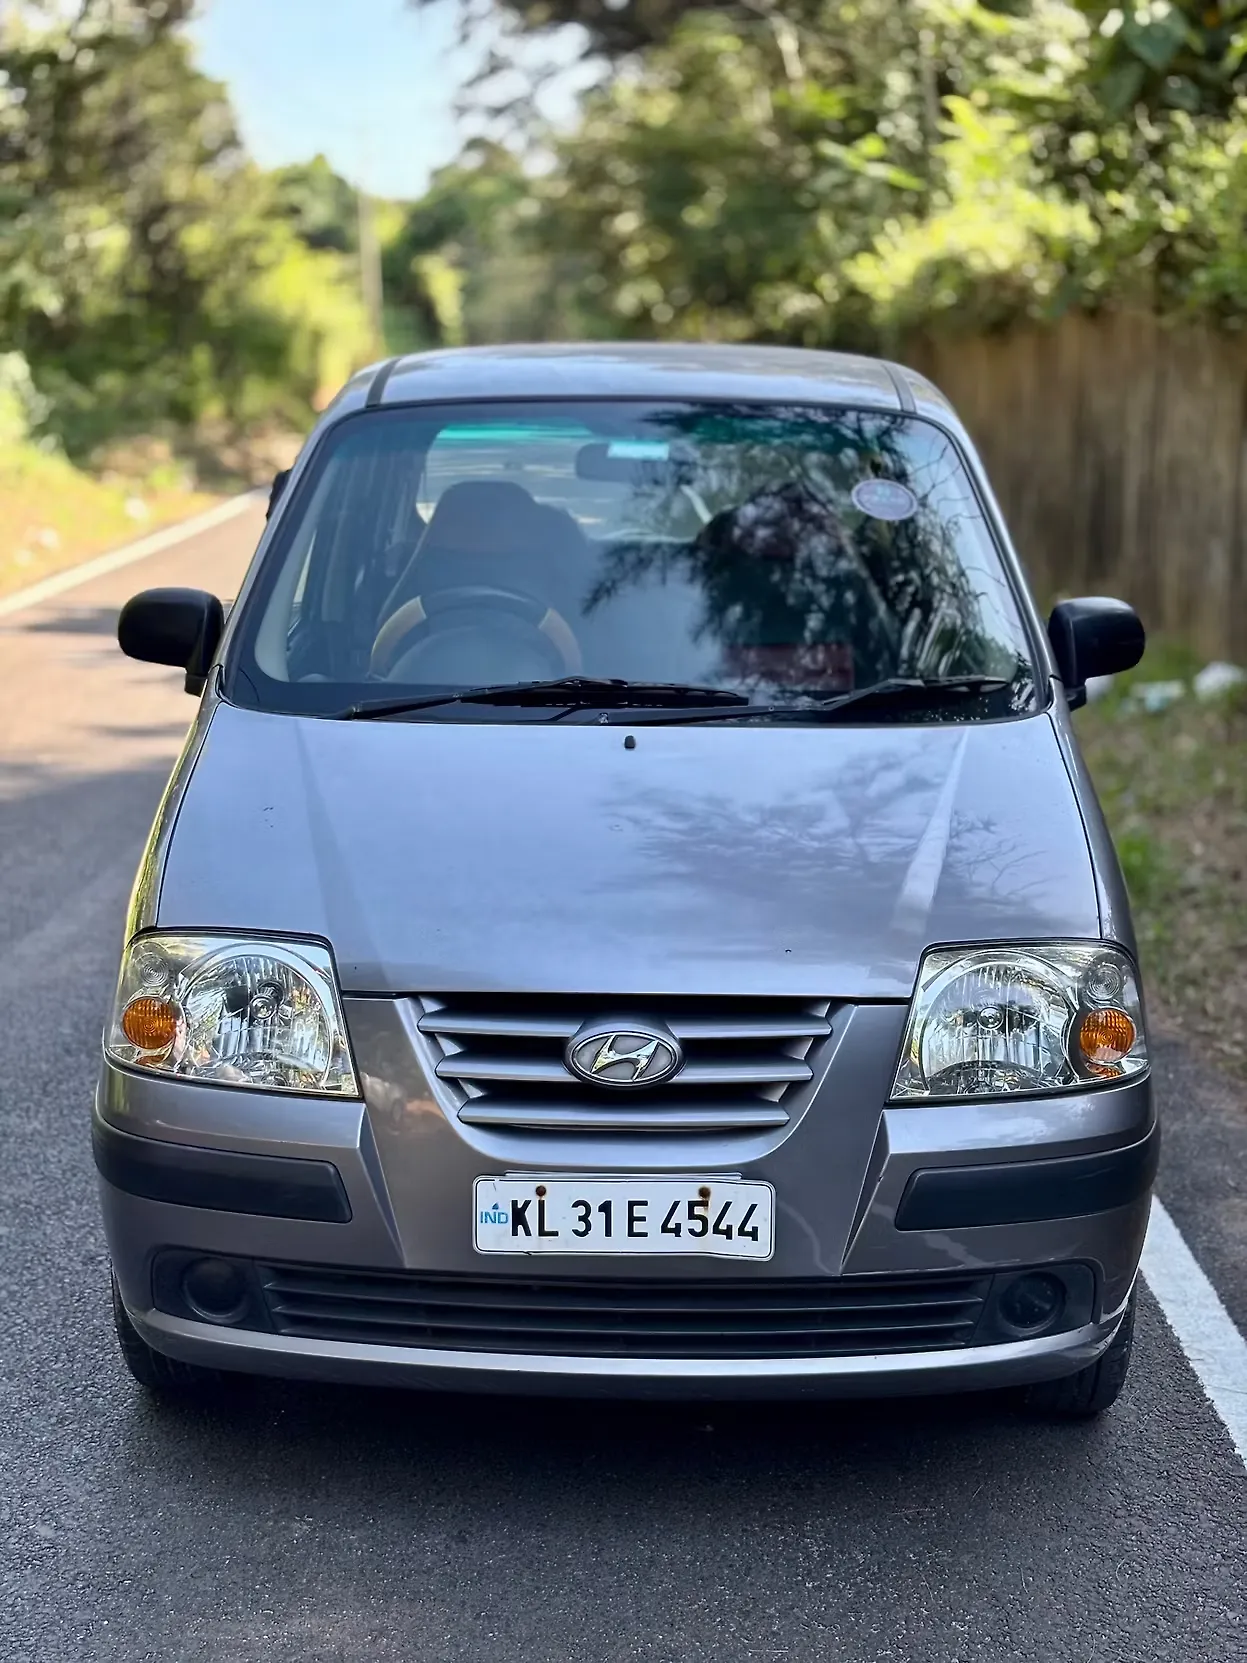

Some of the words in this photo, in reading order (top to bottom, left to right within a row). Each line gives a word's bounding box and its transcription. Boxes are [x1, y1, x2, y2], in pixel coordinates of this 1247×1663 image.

[480, 1210, 509, 1225] IND
[511, 1199, 559, 1237] KL
[571, 1199, 612, 1238] 31
[627, 1200, 649, 1237] E
[660, 1200, 760, 1242] 4544
